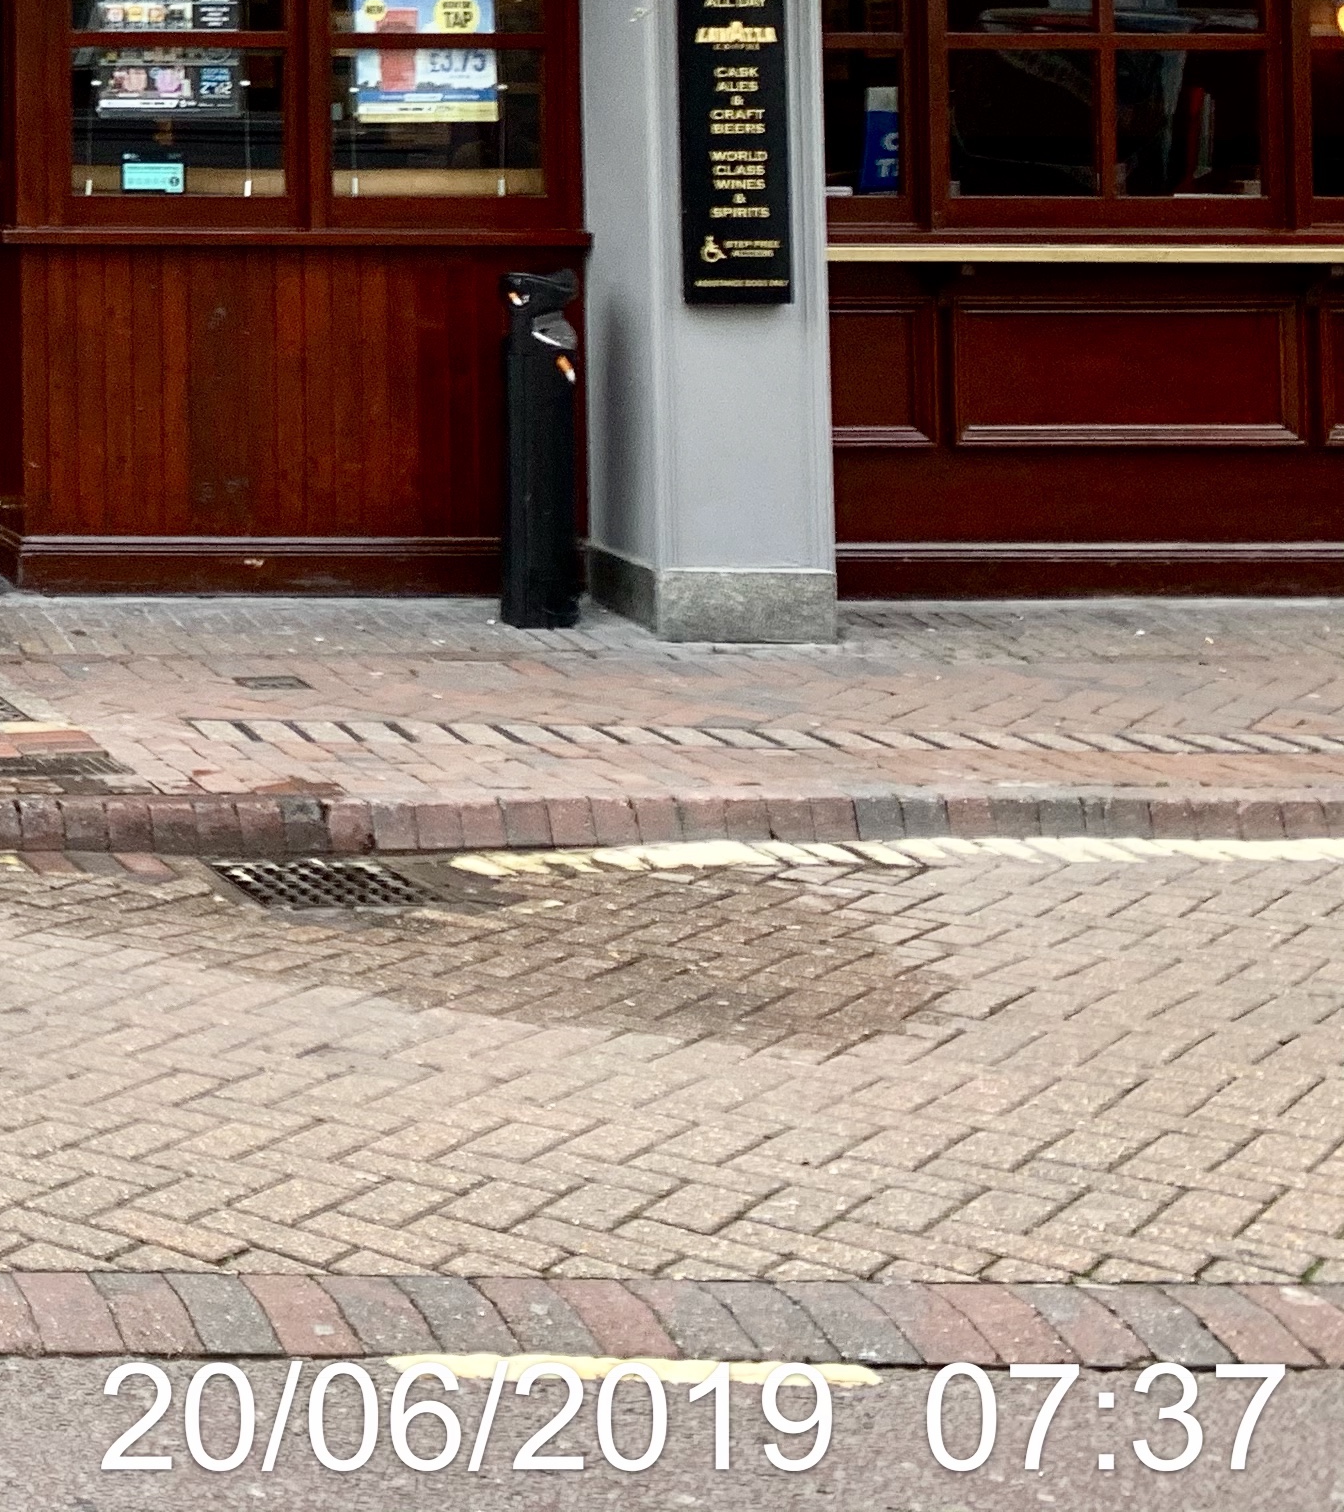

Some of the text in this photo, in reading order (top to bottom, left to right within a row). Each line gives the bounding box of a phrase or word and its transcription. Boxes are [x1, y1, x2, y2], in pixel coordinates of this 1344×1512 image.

[443, 11, 473, 28] TAP
[714, 67, 759, 77] CASK
[715, 81, 759, 92] ALES
[730, 95, 744, 106] &
[710, 109, 765, 120] CRAFT
[710, 123, 765, 134] BEERS
[709, 151, 768, 161] WORLD
[713, 165, 765, 175] CLASS
[713, 179, 765, 190] WINES
[732, 193, 747, 204] &
[710, 207, 771, 218] SPIRITS
